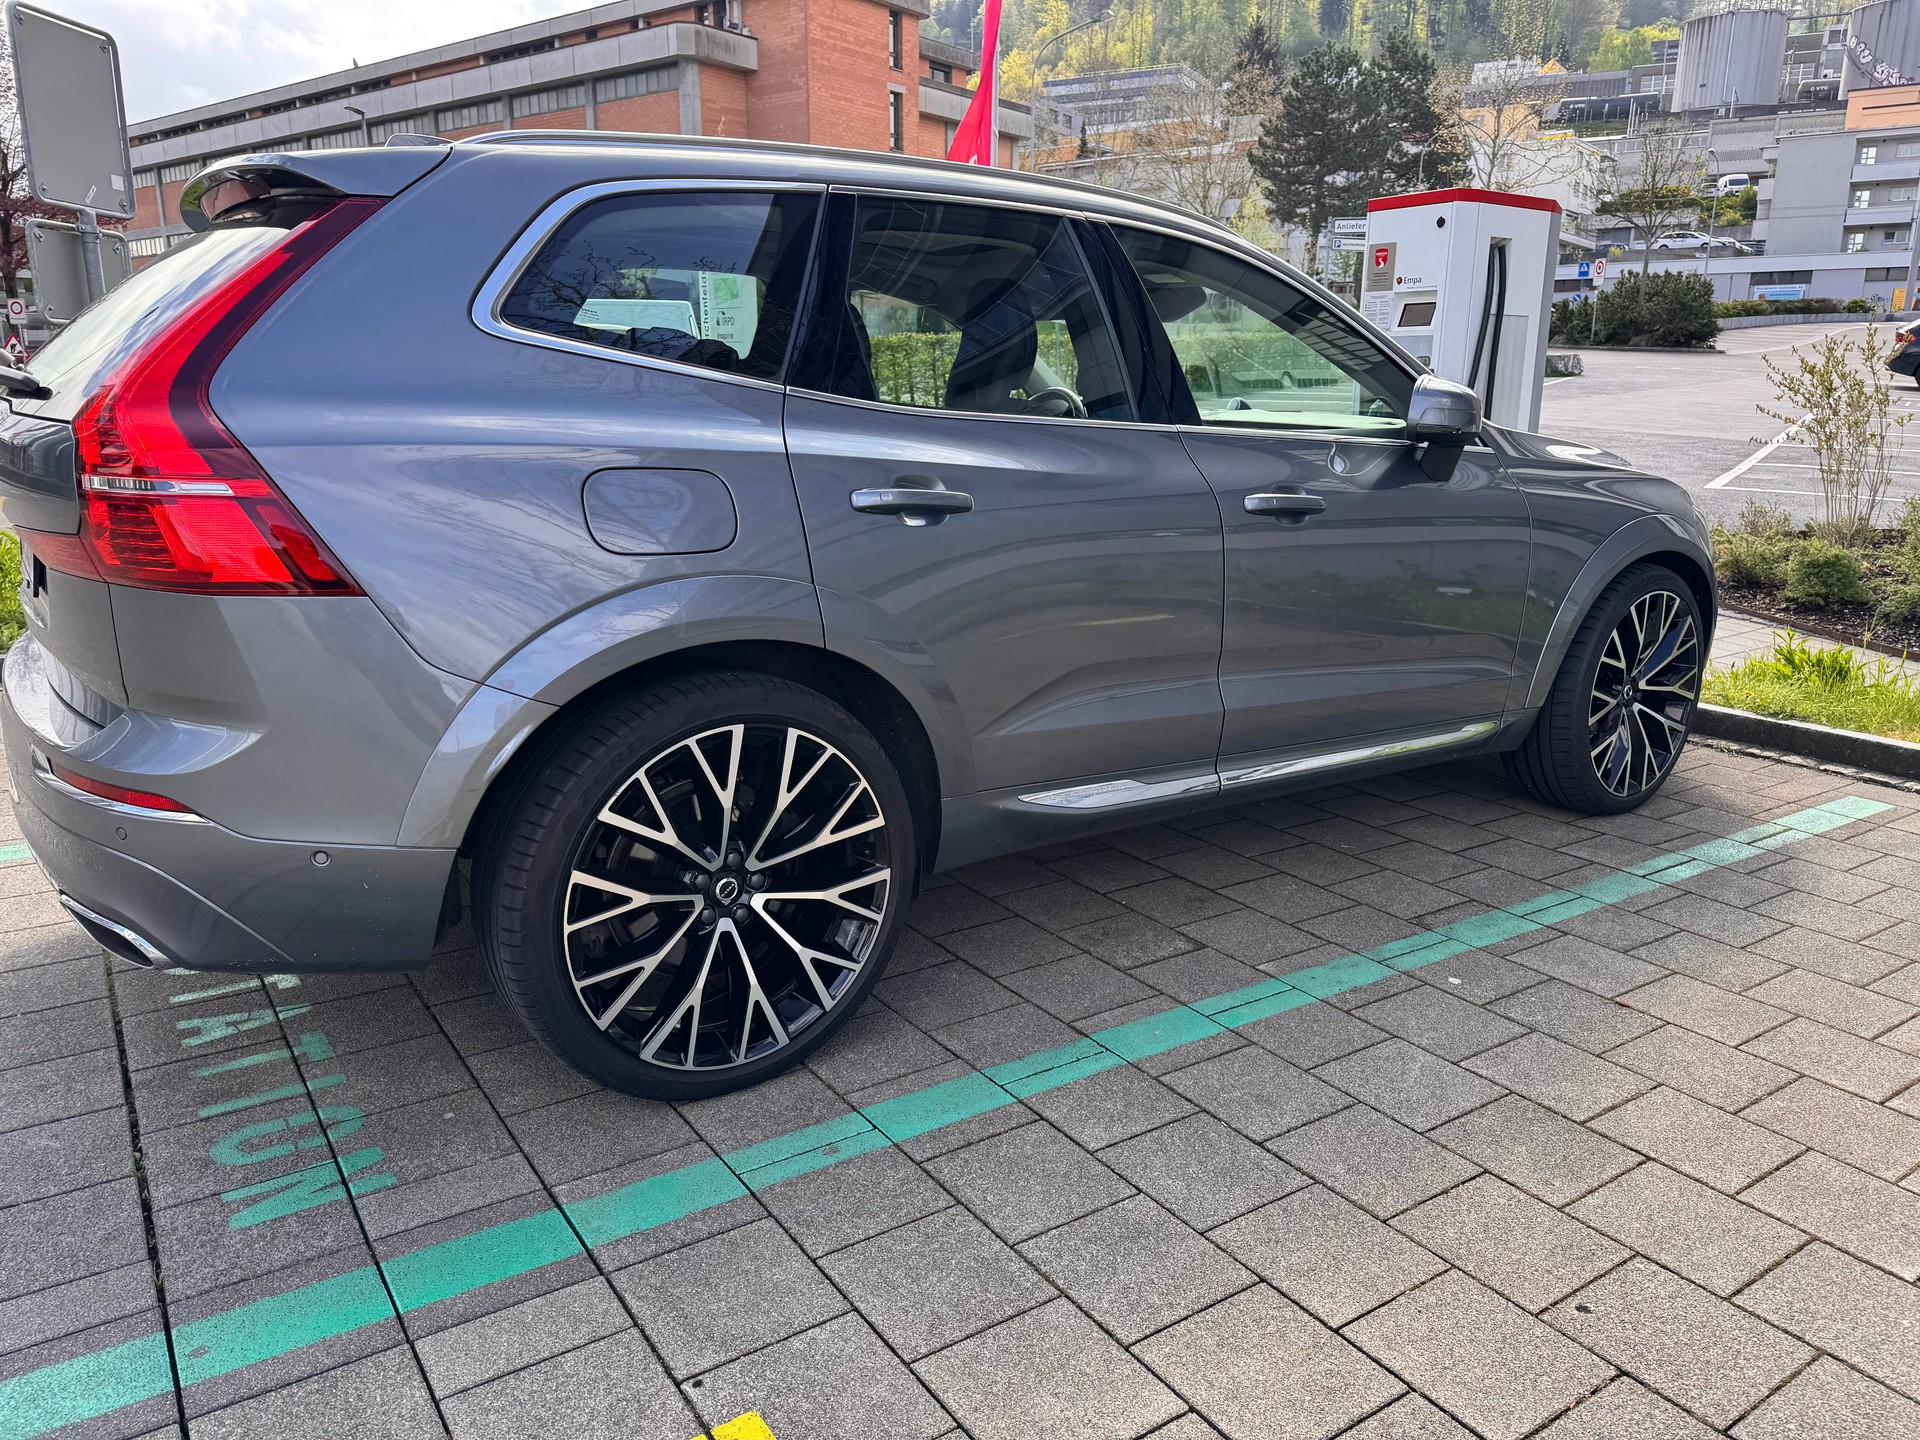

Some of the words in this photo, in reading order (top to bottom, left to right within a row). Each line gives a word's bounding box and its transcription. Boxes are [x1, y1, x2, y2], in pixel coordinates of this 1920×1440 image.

[1336, 222, 1367, 230] Anliefer
[1403, 276, 1422, 285] Empa
[165, 967, 398, 1230] TATION
